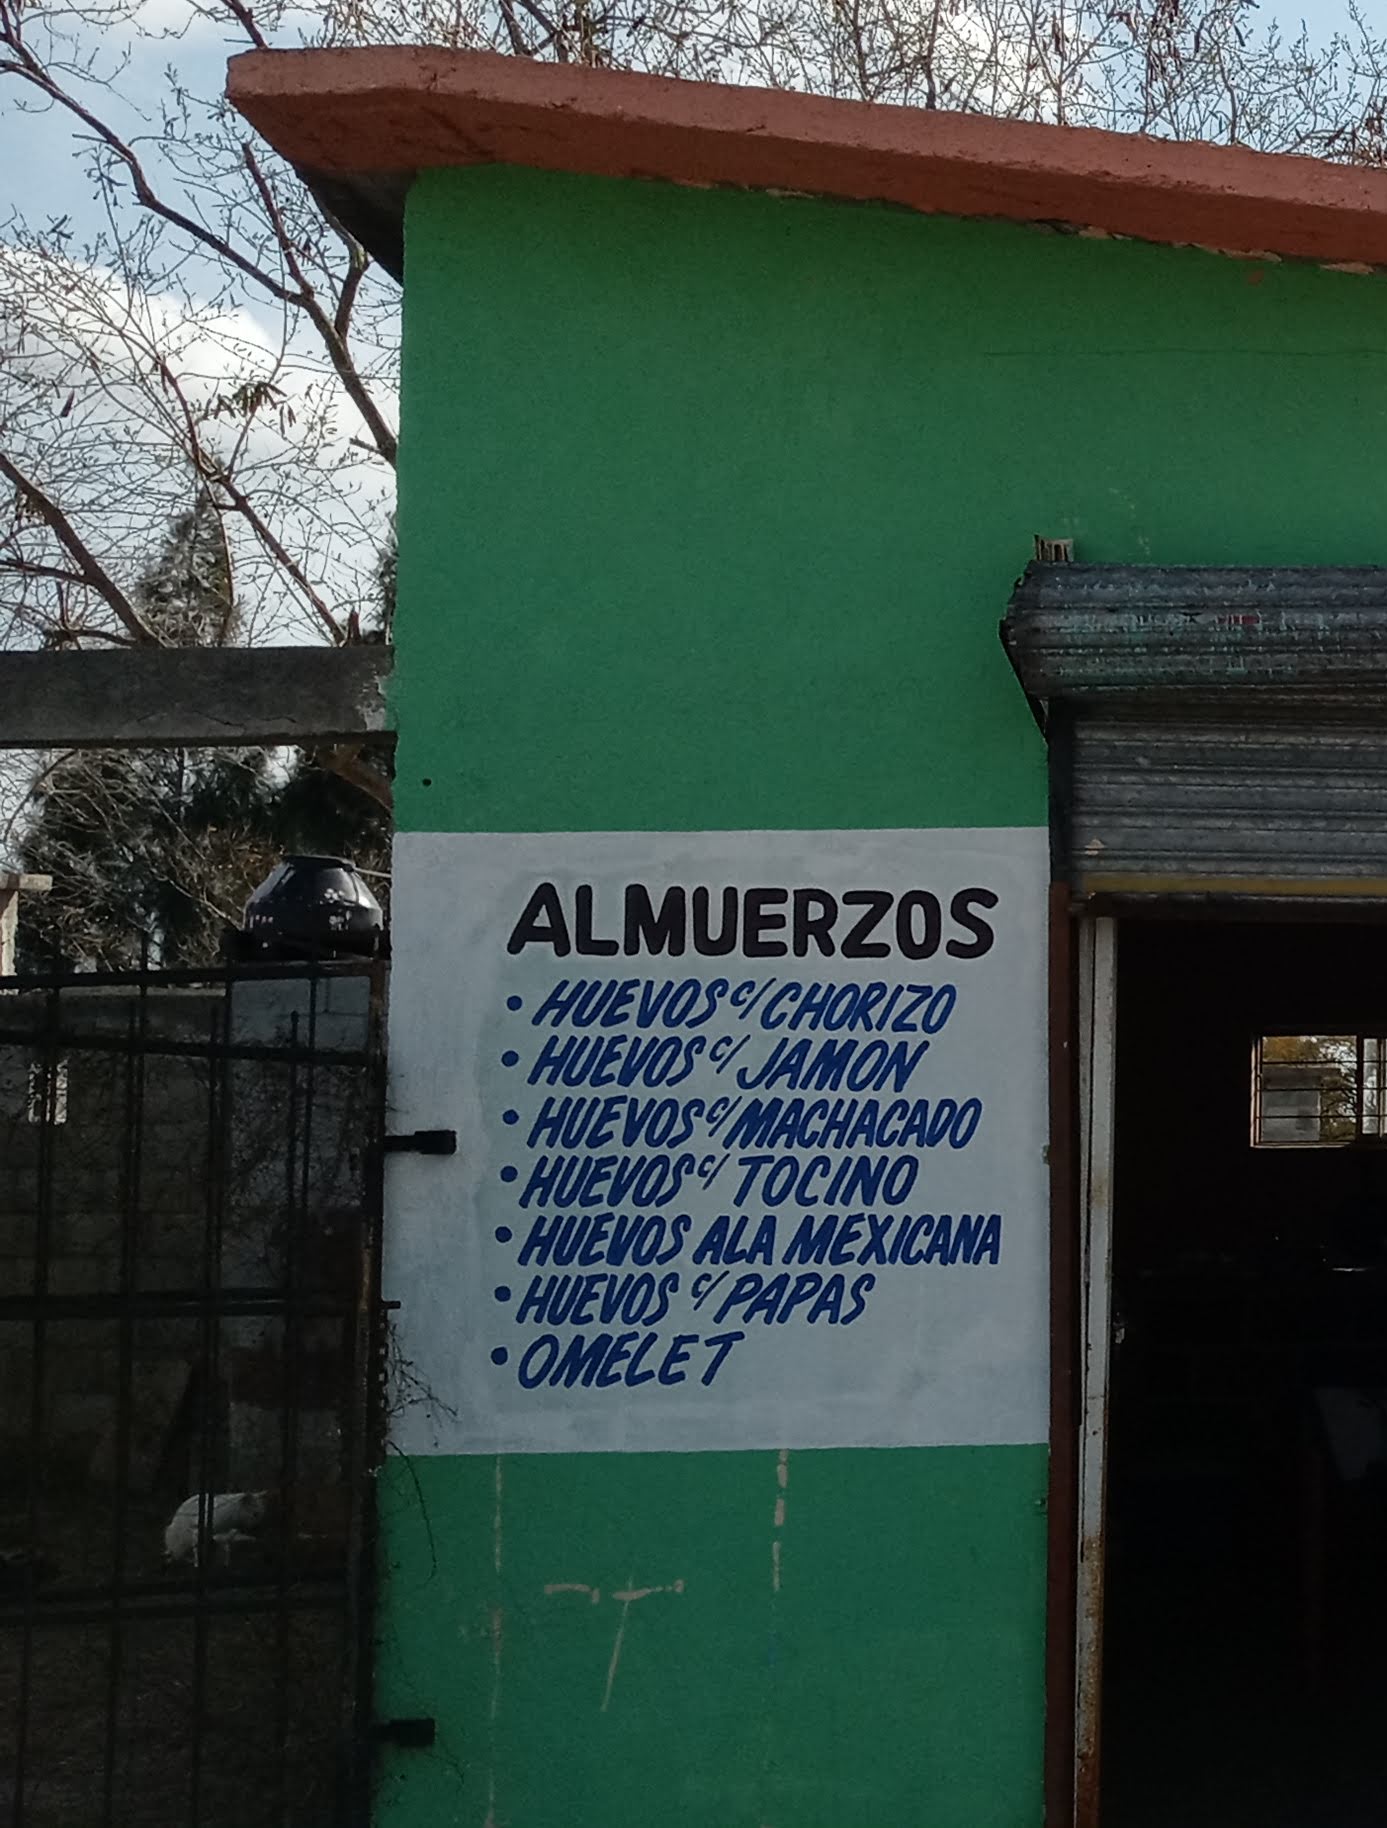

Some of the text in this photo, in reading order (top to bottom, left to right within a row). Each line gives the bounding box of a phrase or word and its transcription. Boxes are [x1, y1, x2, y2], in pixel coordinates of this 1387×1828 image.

[505, 881, 1000, 962] ALMUERZOS
[530, 977, 731, 1030] HUEVOS
[525, 1032, 708, 1089] HUEVOS
[735, 1036, 932, 1094] JAMON
[525, 1094, 707, 1151] HUEVOS
[517, 1152, 697, 1210] HUEVOS
[731, 1153, 921, 1209] TOCINO
[515, 1212, 693, 1268] HUEVOS
[780, 1212, 1003, 1268] MEXICANA
[514, 1271, 681, 1328] HUEVOS
[516, 1329, 747, 1391] OMELET
